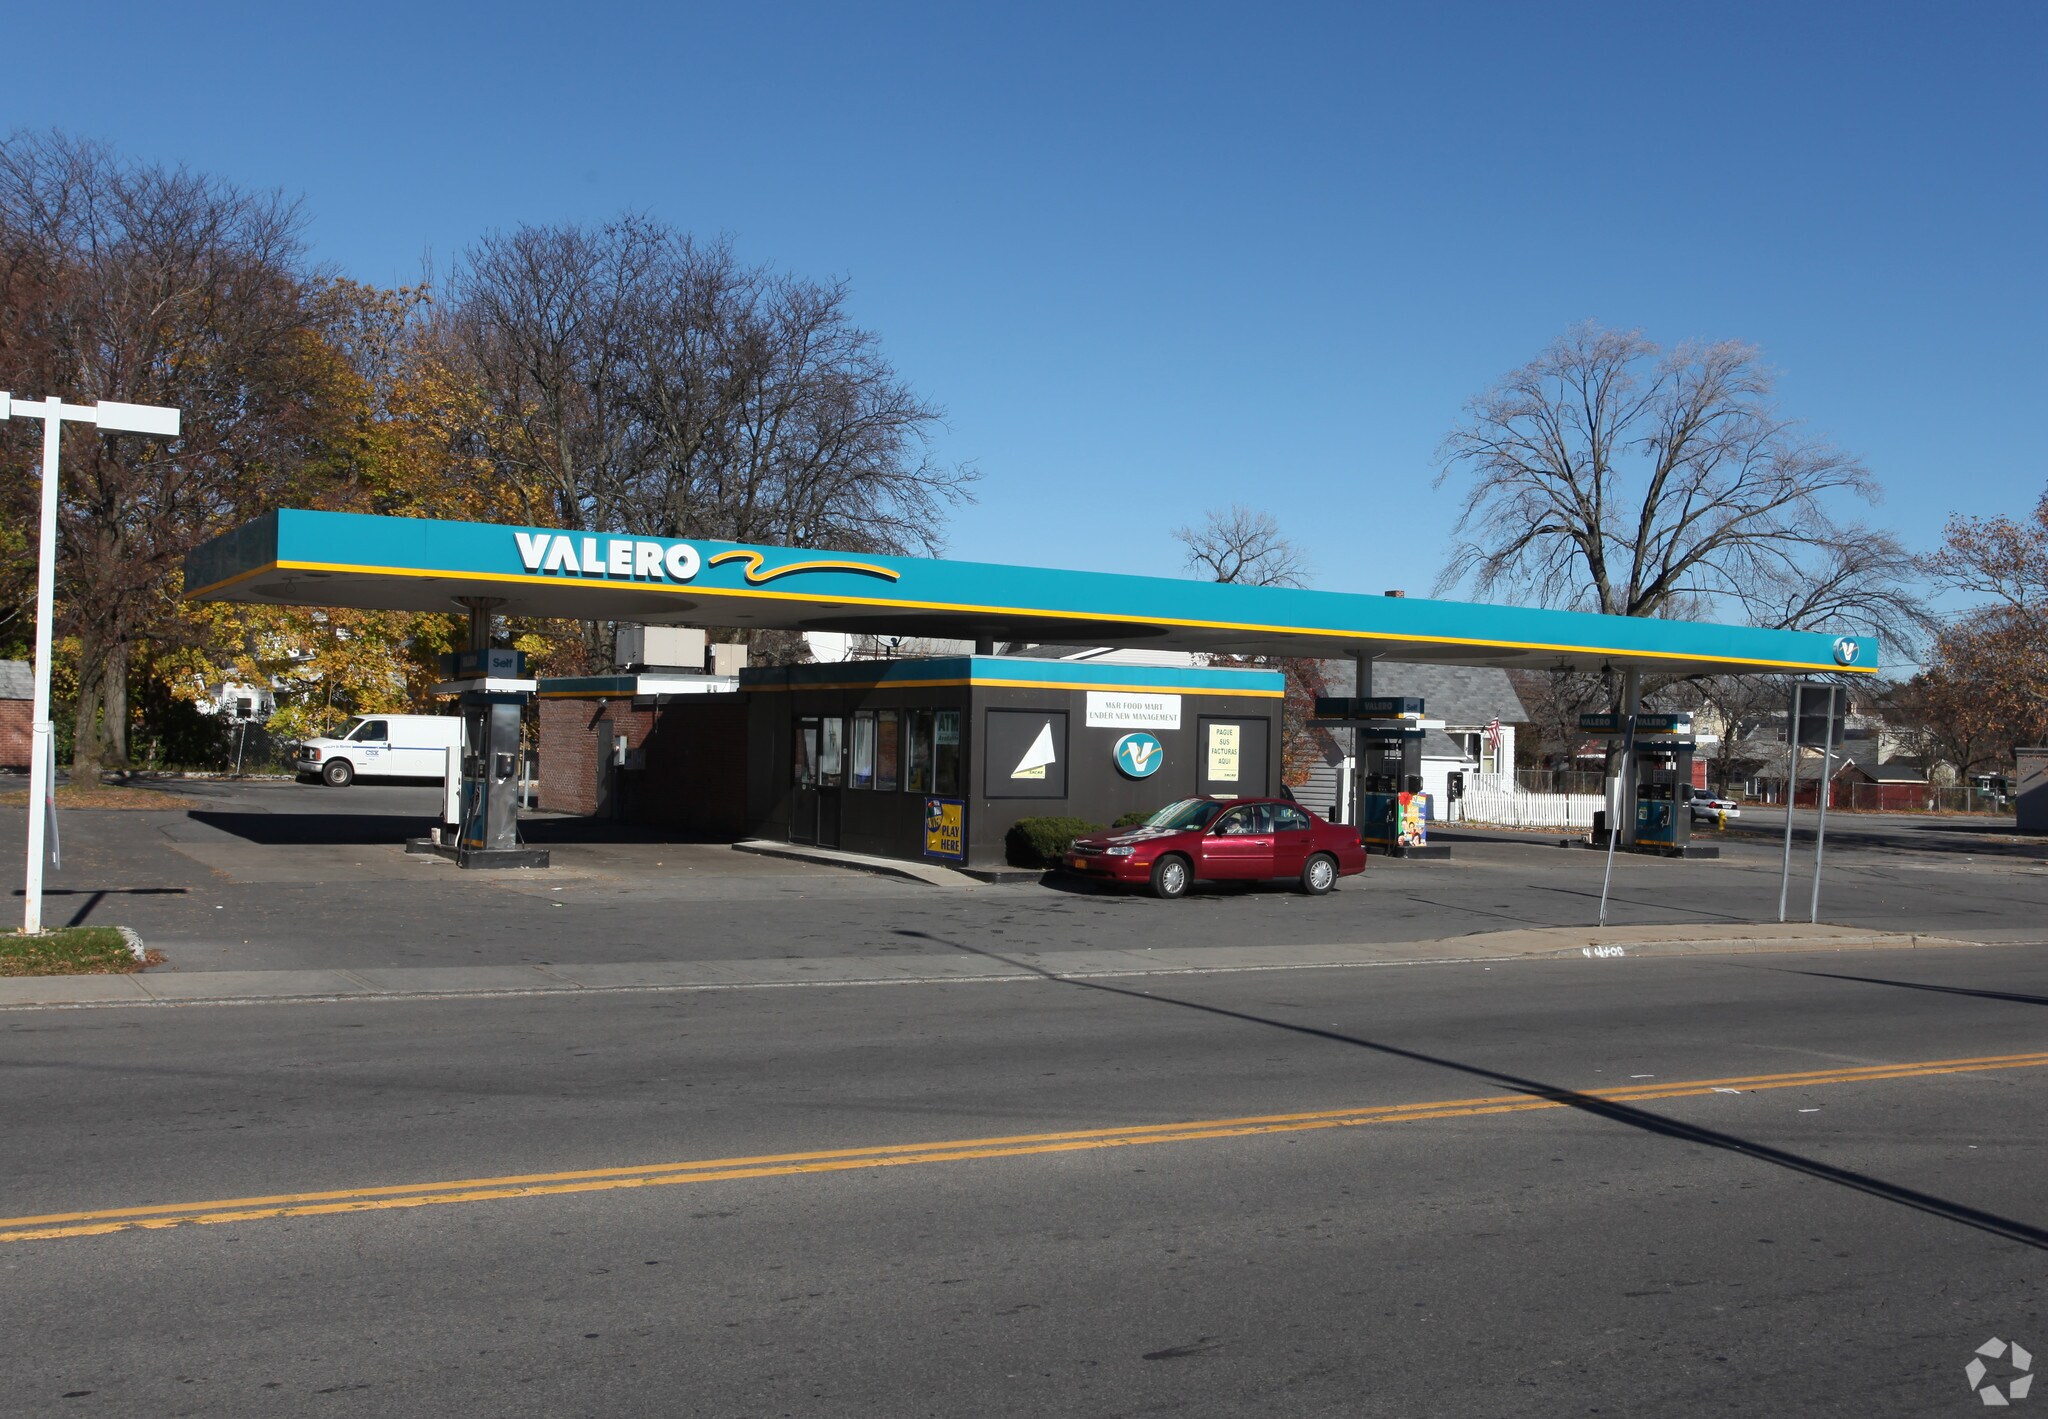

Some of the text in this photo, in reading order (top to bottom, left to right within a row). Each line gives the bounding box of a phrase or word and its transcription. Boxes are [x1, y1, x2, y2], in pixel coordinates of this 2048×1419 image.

[514, 532, 701, 580] VALERO
[1841, 642, 1855, 661] V
[493, 657, 513, 668] Self
[1105, 701, 1163, 711] M&R FOOD MART
[1364, 702, 1393, 711] VALERO
[938, 713, 959, 731] ATM
[1089, 711, 1178, 722] UNDER NEW MANAGEMENT
[1580, 718, 1610, 726] VALERO
[1637, 718, 1667, 726] VALERO
[1216, 728, 1233, 736] PAGUE
[1219, 738, 1230, 746] SUS
[1127, 742, 1154, 772] V
[942, 825, 960, 838] PLAY
[941, 839, 959, 852] HERE
